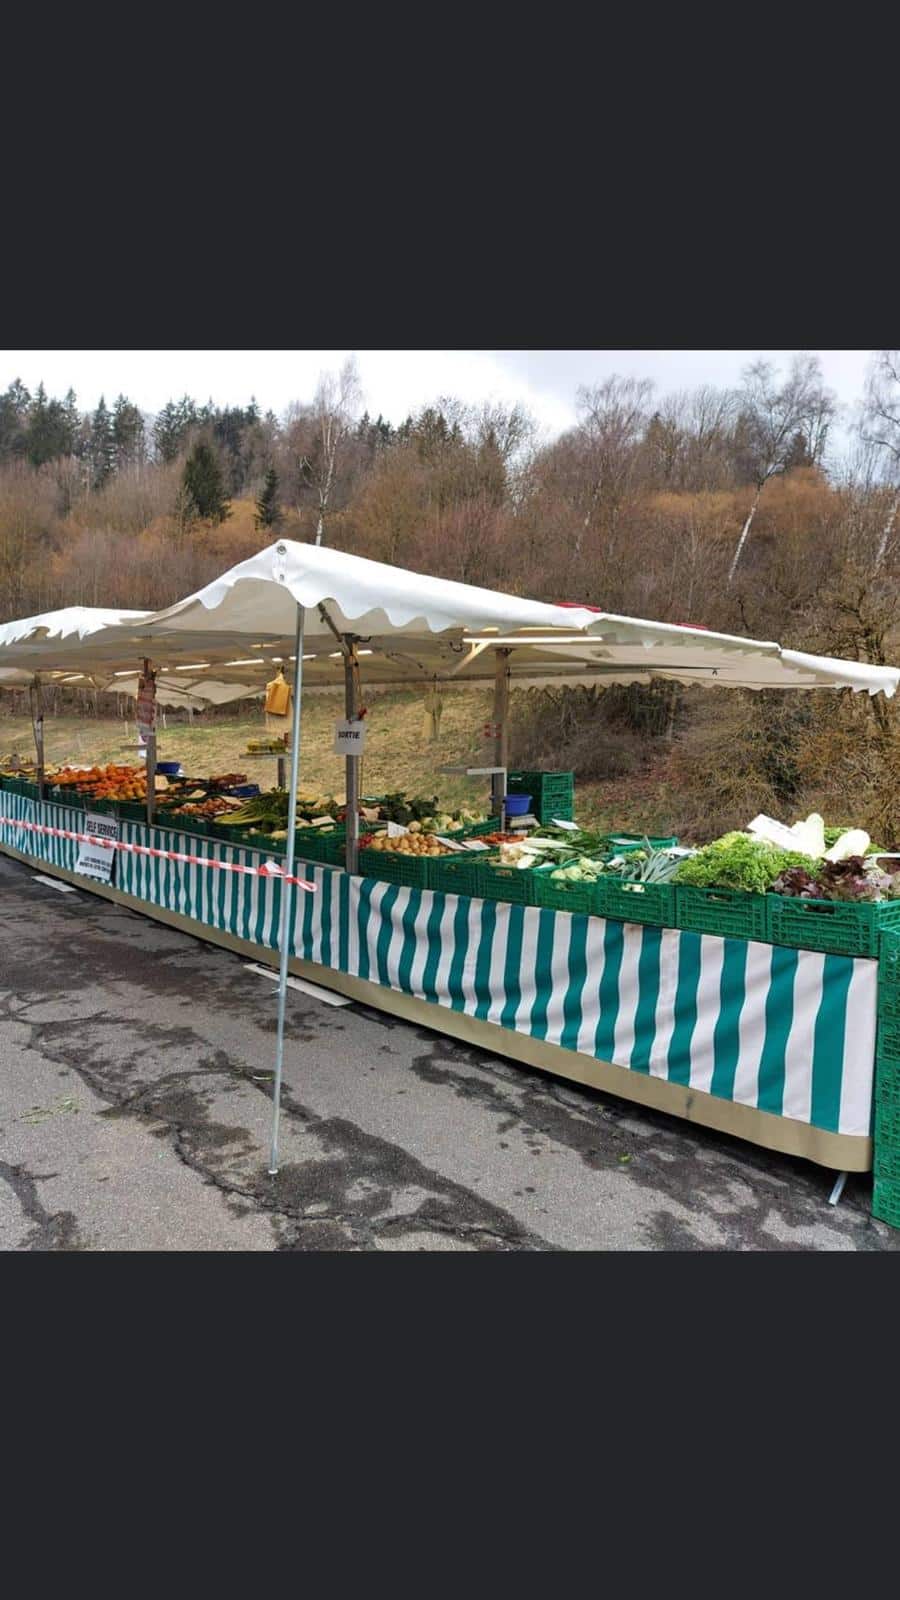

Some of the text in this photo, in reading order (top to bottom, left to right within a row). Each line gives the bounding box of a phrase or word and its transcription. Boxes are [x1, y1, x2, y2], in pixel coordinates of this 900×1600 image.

[338, 731, 360, 739] SORTIE
[86, 820, 117, 837] SELF SERVICE
